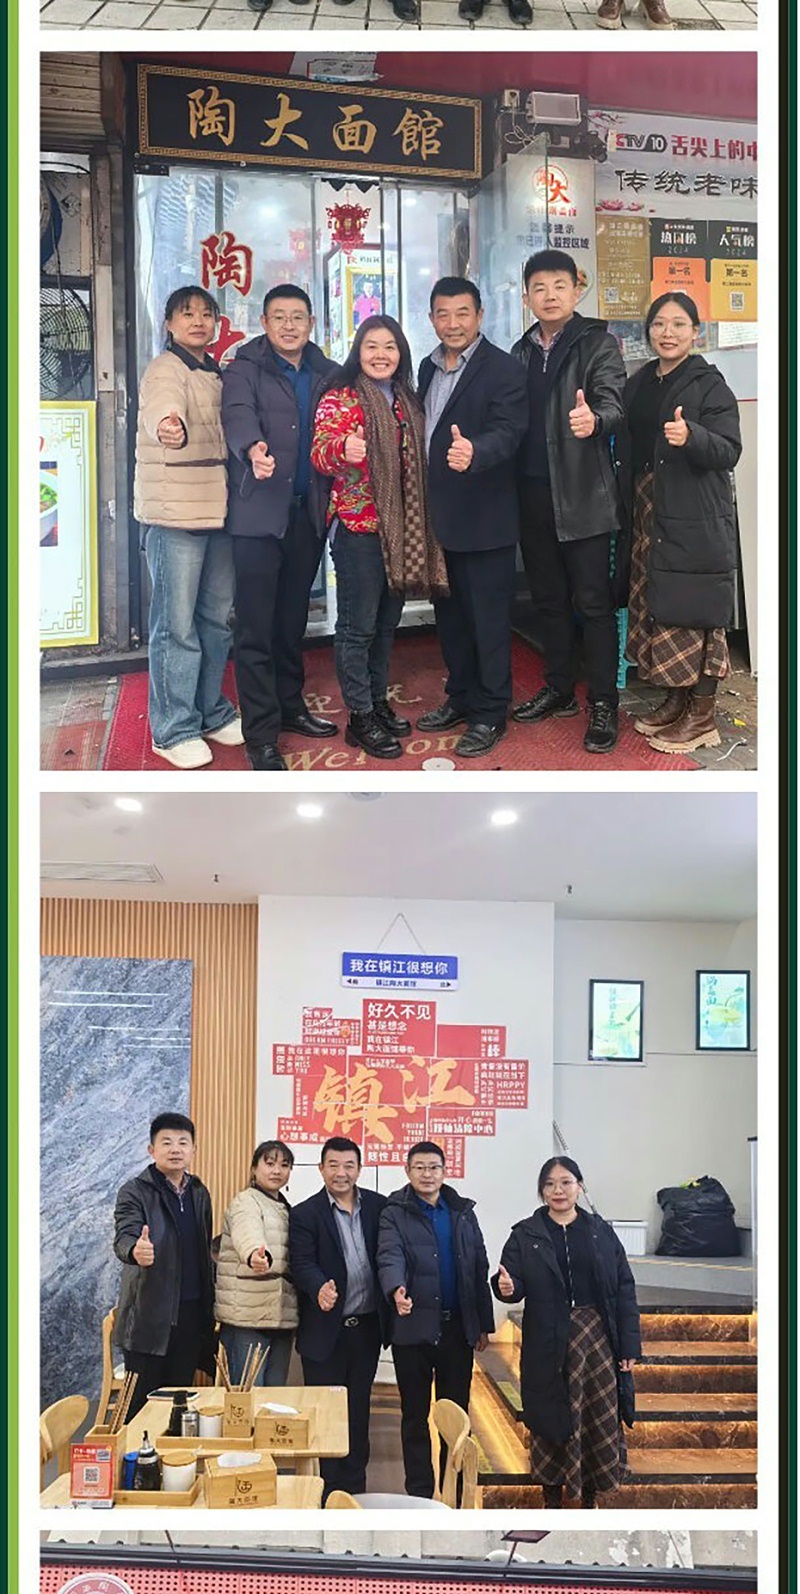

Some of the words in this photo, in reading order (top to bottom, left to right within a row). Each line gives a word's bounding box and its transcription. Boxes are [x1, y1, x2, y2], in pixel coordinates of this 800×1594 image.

[187, 86, 444, 160] 陶大面館
[350, 959, 449, 975] 我在镇江很想你
[367, 1002, 431, 1020] 好久不见
[314, 1056, 475, 1144] 镇江
